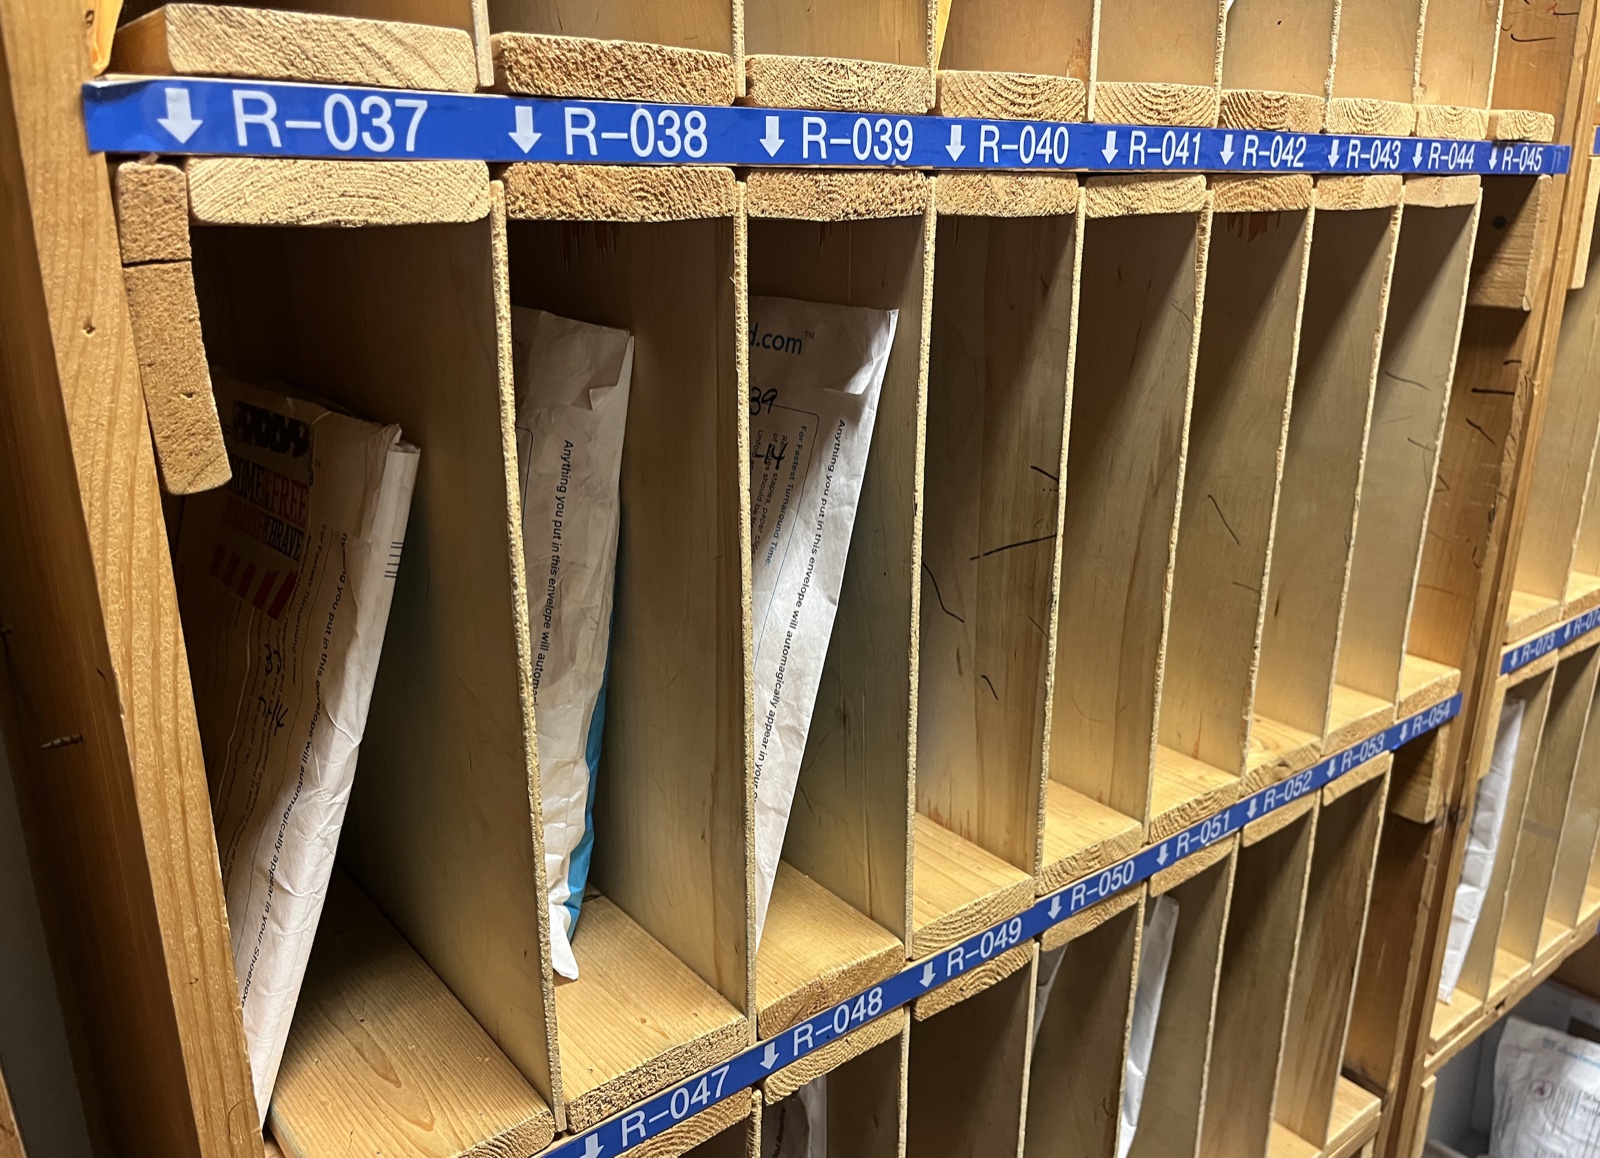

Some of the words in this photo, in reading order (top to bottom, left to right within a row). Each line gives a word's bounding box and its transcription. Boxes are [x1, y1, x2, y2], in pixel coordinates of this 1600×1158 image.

[230, 88, 428, 153] R-037
[564, 105, 708, 158] R-038
[801, 116, 914, 163] R-039
[978, 124, 1070, 165] R-040
[1128, 131, 1202, 166] R-041
[1242, 134, 1307, 168] R-042
[1346, 139, 1402, 169] R-043
[1427, 142, 1476, 171] R-044
[1501, 146, 1544, 173] R-045
[749, 322, 803, 355] d.com
[798, 425, 807, 442] For
[828, 419, 845, 472] Anything
[556, 439, 574, 494] Anything
[790, 444, 803, 480] Fastest
[824, 474, 833, 496] you
[555, 495, 566, 518] you
[758, 508, 768, 533] paper
[774, 483, 794, 538] Turnaround
[818, 498, 827, 519] put
[552, 519, 562, 540] put
[817, 520, 824, 530] in
[551, 541, 562, 553] in
[811, 534, 822, 555] this
[550, 555, 561, 576] this
[796, 556, 816, 608] envelope
[333, 583, 346, 611] you
[543, 578, 557, 629] envelope
[325, 612, 336, 634] put
[790, 609, 799, 630] will
[322, 637, 330, 650] in
[540, 631, 550, 652] will
[1520, 631, 1555, 663] R-073
[317, 652, 328, 678] this
[770, 630, 794, 709] automagically
[761, 709, 776, 750] appear
[1411, 700, 1451, 736] R-054
[301, 741, 312, 764] will
[758, 750, 768, 761] in
[1341, 733, 1386, 773] R-053
[1263, 769, 1313, 813] R-052
[275, 765, 305, 854] automagically
[1176, 811, 1231, 858] R-051
[267, 854, 279, 901] appear
[1070, 859, 1135, 912] R-050
[264, 901, 272, 914] in
[257, 913, 268, 946] your
[946, 916, 1022, 977] R-049
[240, 946, 261, 1009] Shoeboxe
[793, 986, 883, 1057] R-048
[621, 1064, 730, 1148] R-047
